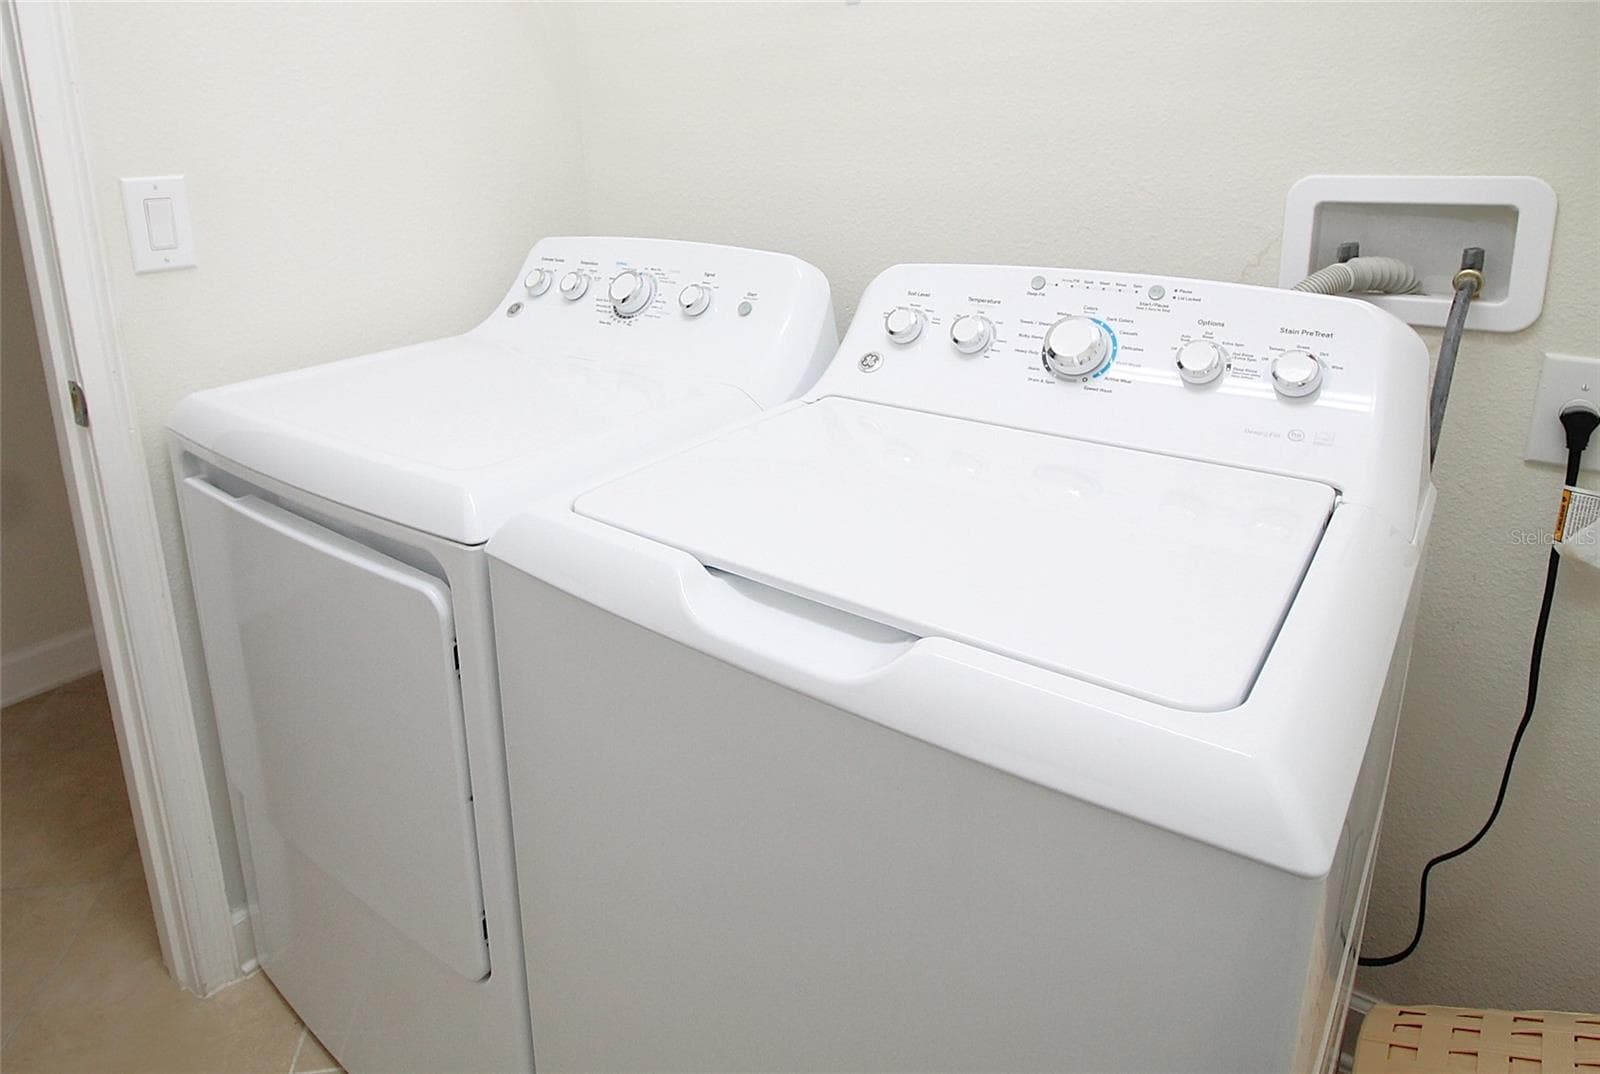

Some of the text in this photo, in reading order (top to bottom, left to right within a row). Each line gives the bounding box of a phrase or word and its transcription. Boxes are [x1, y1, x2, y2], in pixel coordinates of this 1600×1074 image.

[968, 296, 1002, 305] Temperature
[1197, 319, 1225, 328] Options
[1279, 327, 1300, 336] Stain
